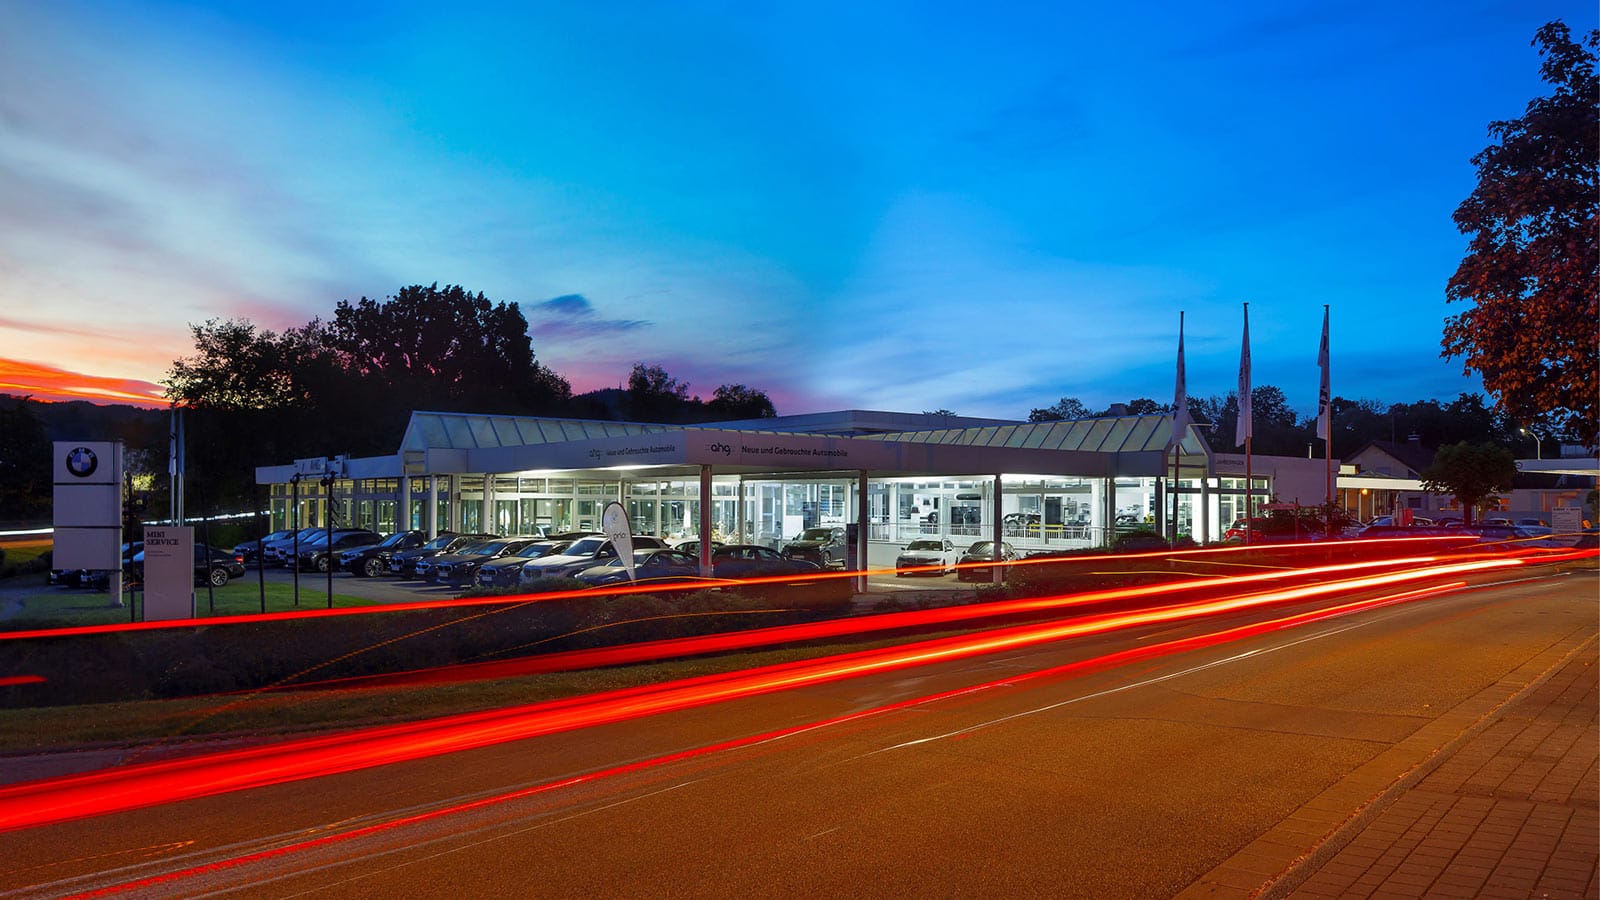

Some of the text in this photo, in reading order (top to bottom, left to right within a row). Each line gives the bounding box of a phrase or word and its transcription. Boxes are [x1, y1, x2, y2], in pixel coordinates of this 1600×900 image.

[710, 442, 731, 456] ahg
[741, 445, 848, 458] Neue und Gebrauchte Automobile
